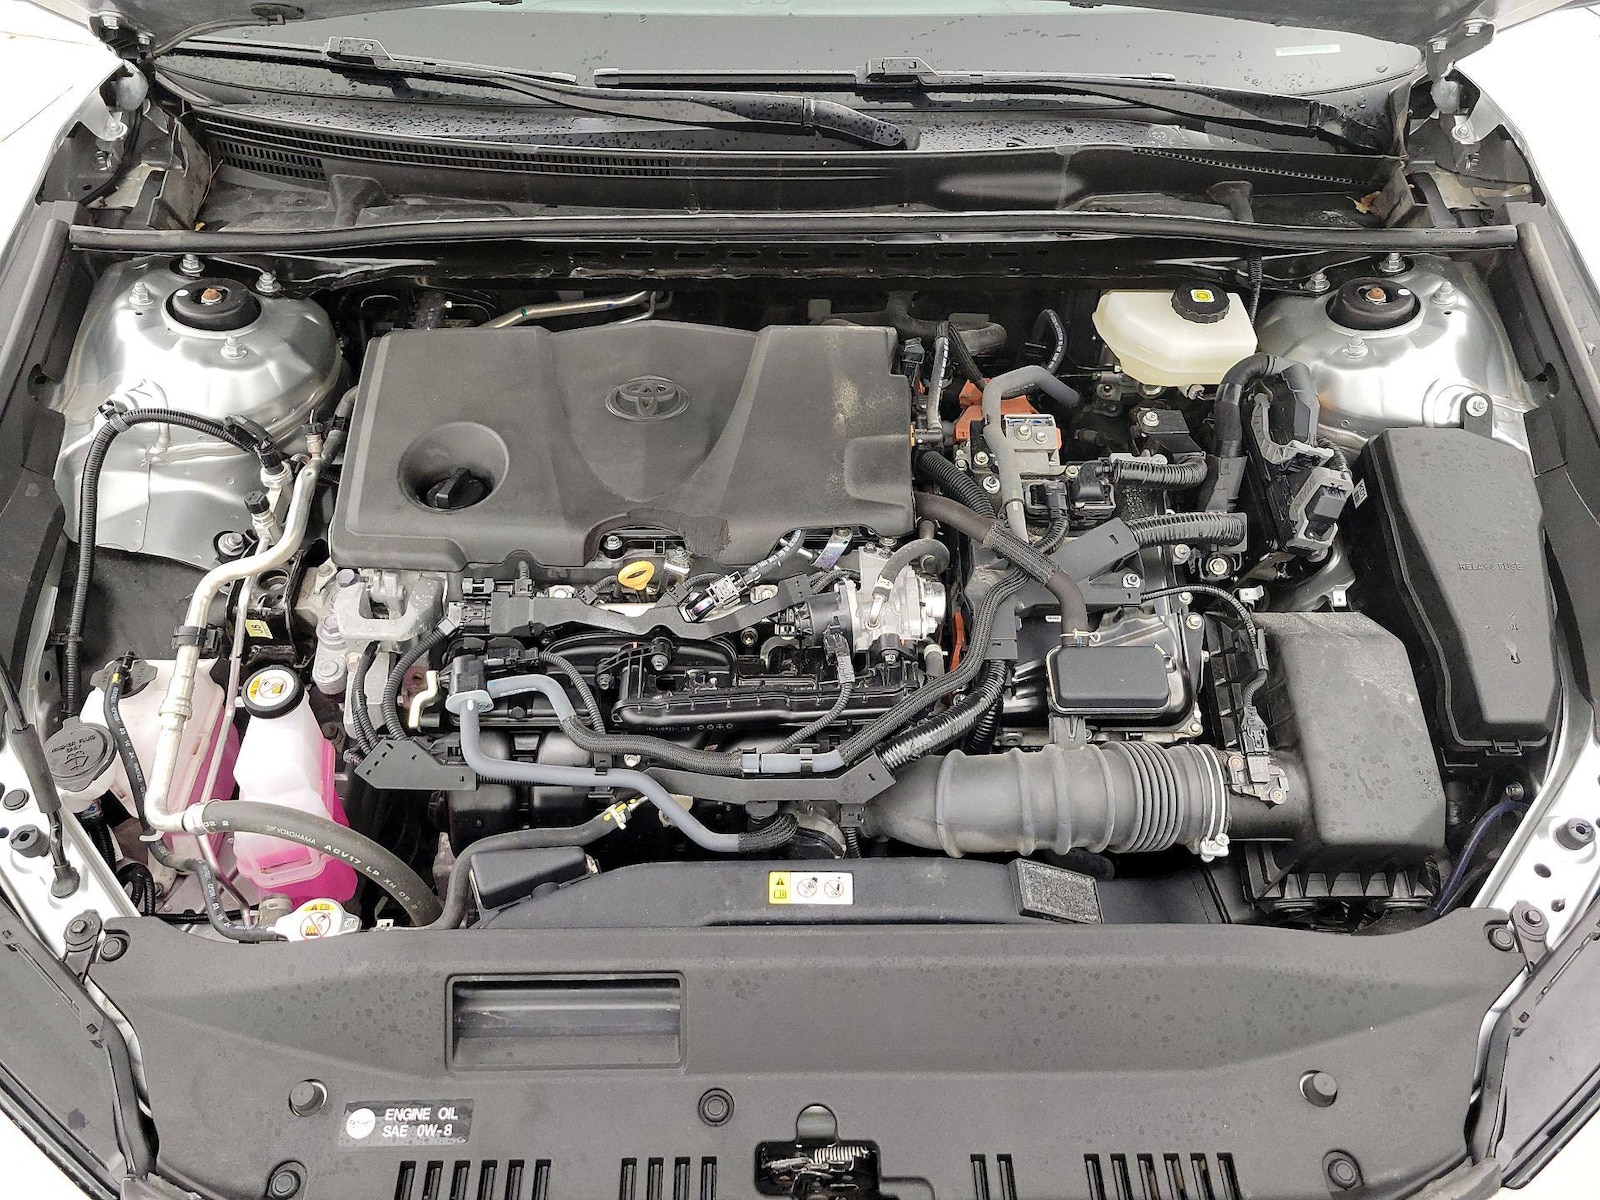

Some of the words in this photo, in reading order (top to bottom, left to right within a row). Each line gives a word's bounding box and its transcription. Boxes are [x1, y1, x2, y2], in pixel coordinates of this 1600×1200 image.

[1458, 562, 1487, 571] RELAY
[1498, 562, 1523, 571] FUSE
[276, 828, 316, 845] YOKOHAMA
[324, 844, 362, 864] ACV17
[365, 865, 380, 876] LP
[384, 1107, 432, 1121] ENGINE
[437, 1107, 459, 1120] OIL
[382, 1124, 409, 1137] SAE
[416, 1124, 453, 1137] 0W-8
